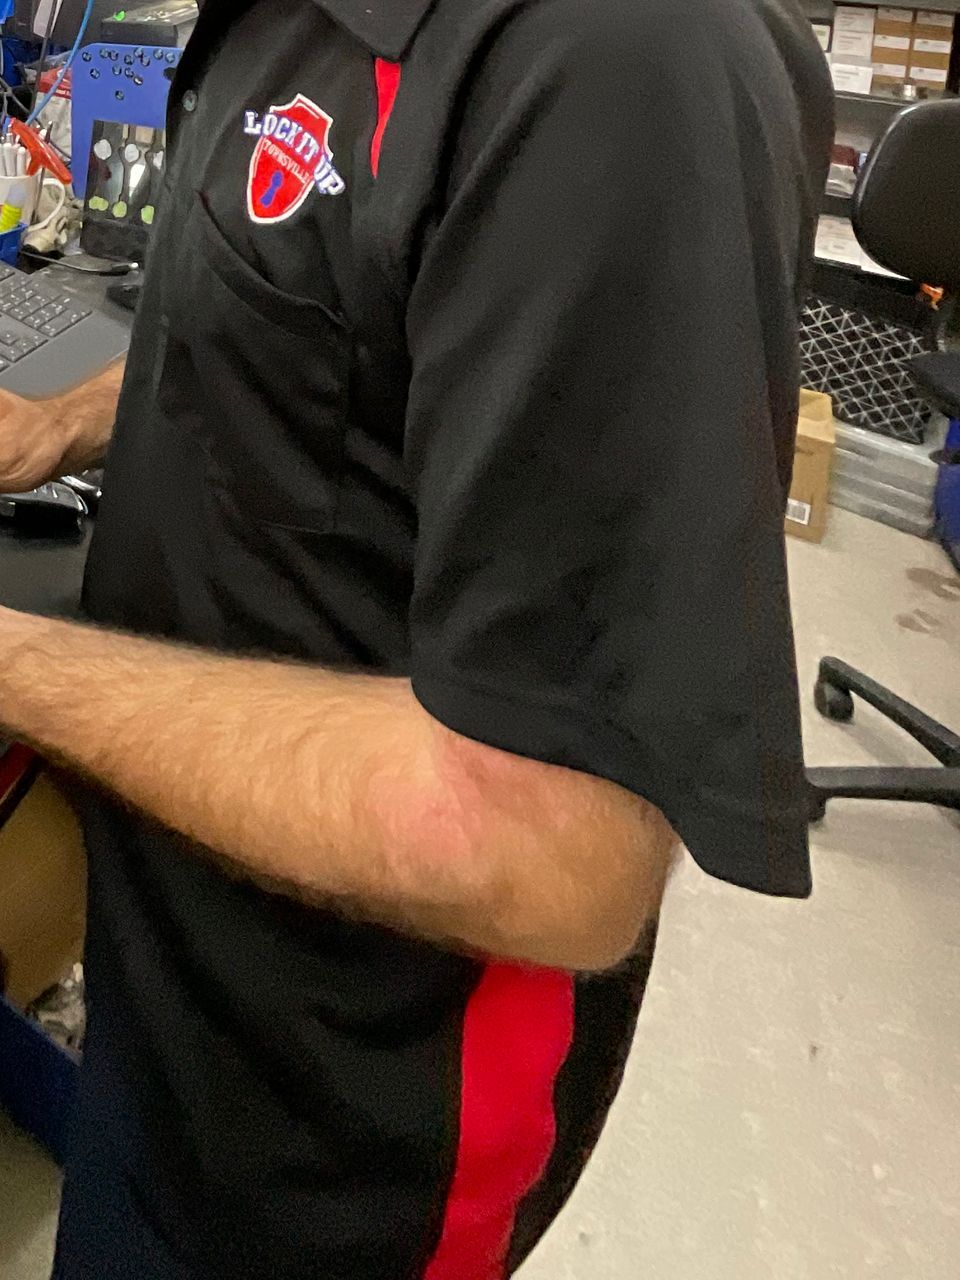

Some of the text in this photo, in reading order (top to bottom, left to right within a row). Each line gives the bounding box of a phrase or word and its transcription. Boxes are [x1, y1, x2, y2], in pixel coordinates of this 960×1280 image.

[244, 110, 345, 196] LOCK IT UP
[262, 138, 311, 184] TOWNSVILLE
